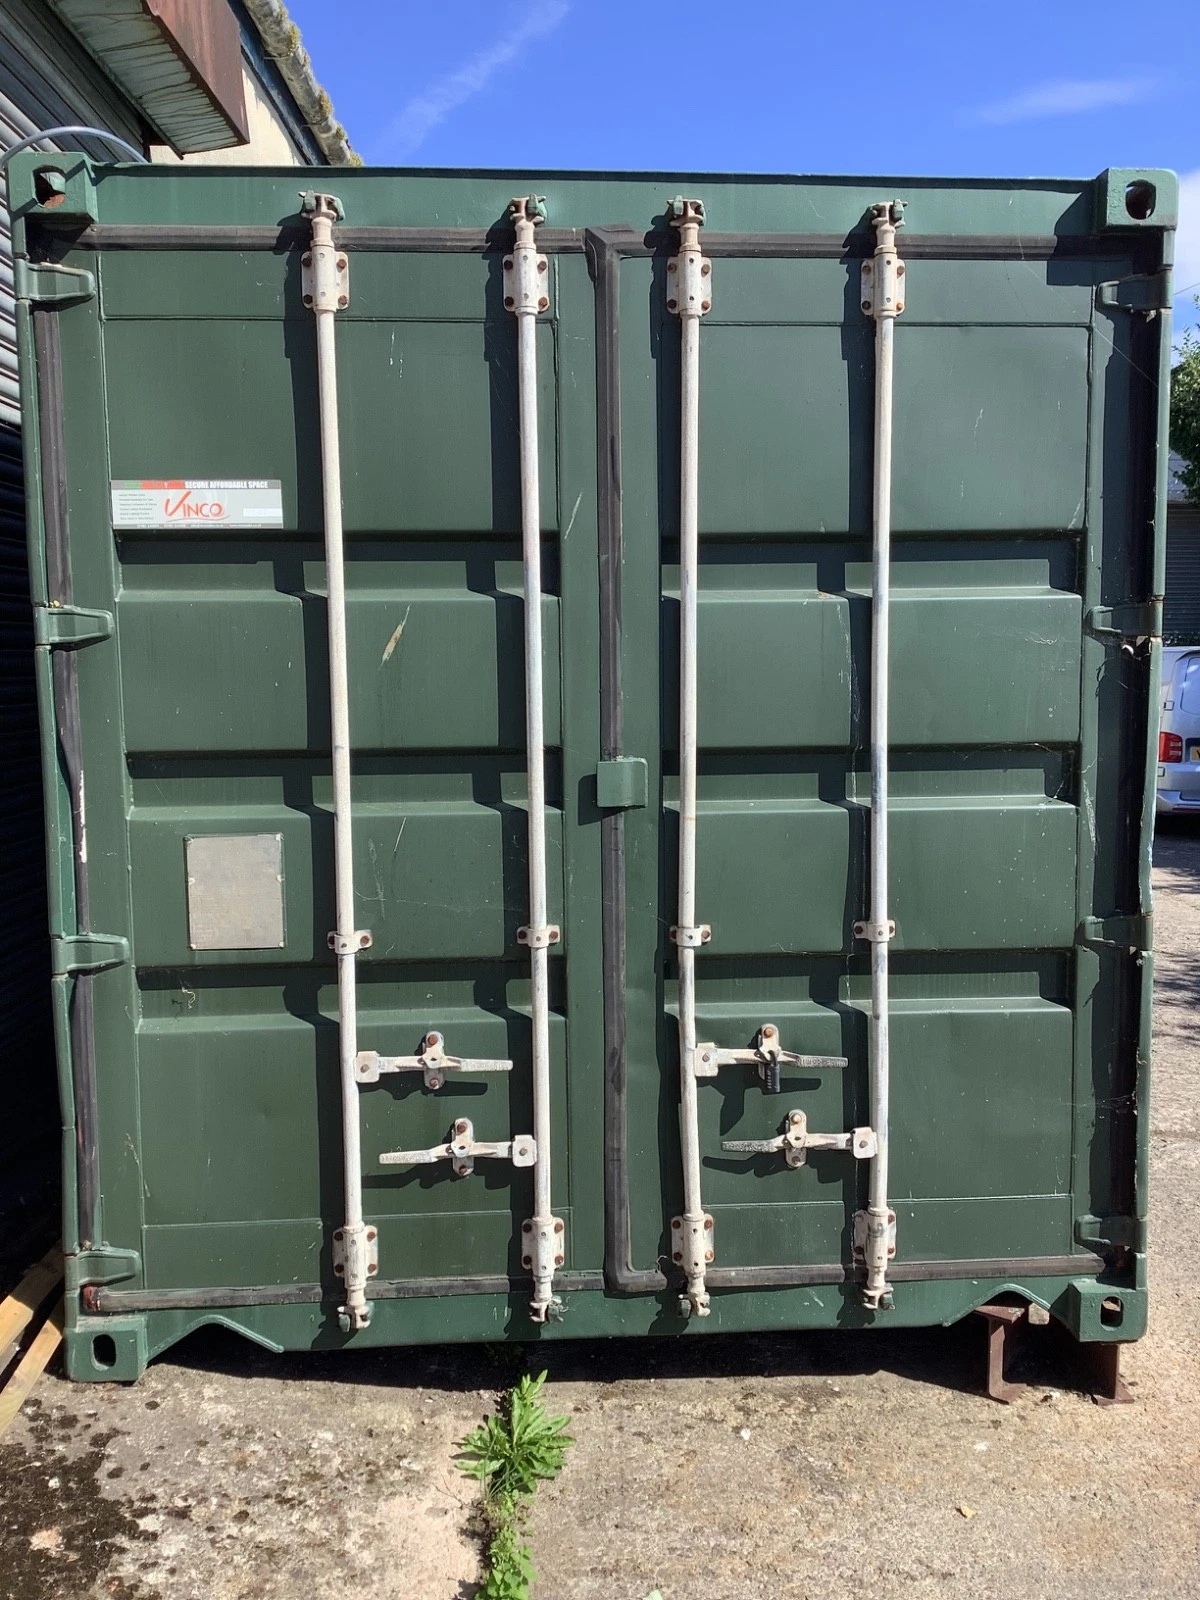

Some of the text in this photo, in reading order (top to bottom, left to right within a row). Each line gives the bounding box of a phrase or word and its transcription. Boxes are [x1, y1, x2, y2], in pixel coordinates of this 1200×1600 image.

[184, 481, 268, 489] SECURE AFFORDABLE SPACE
[165, 490, 223, 517] VINCO
